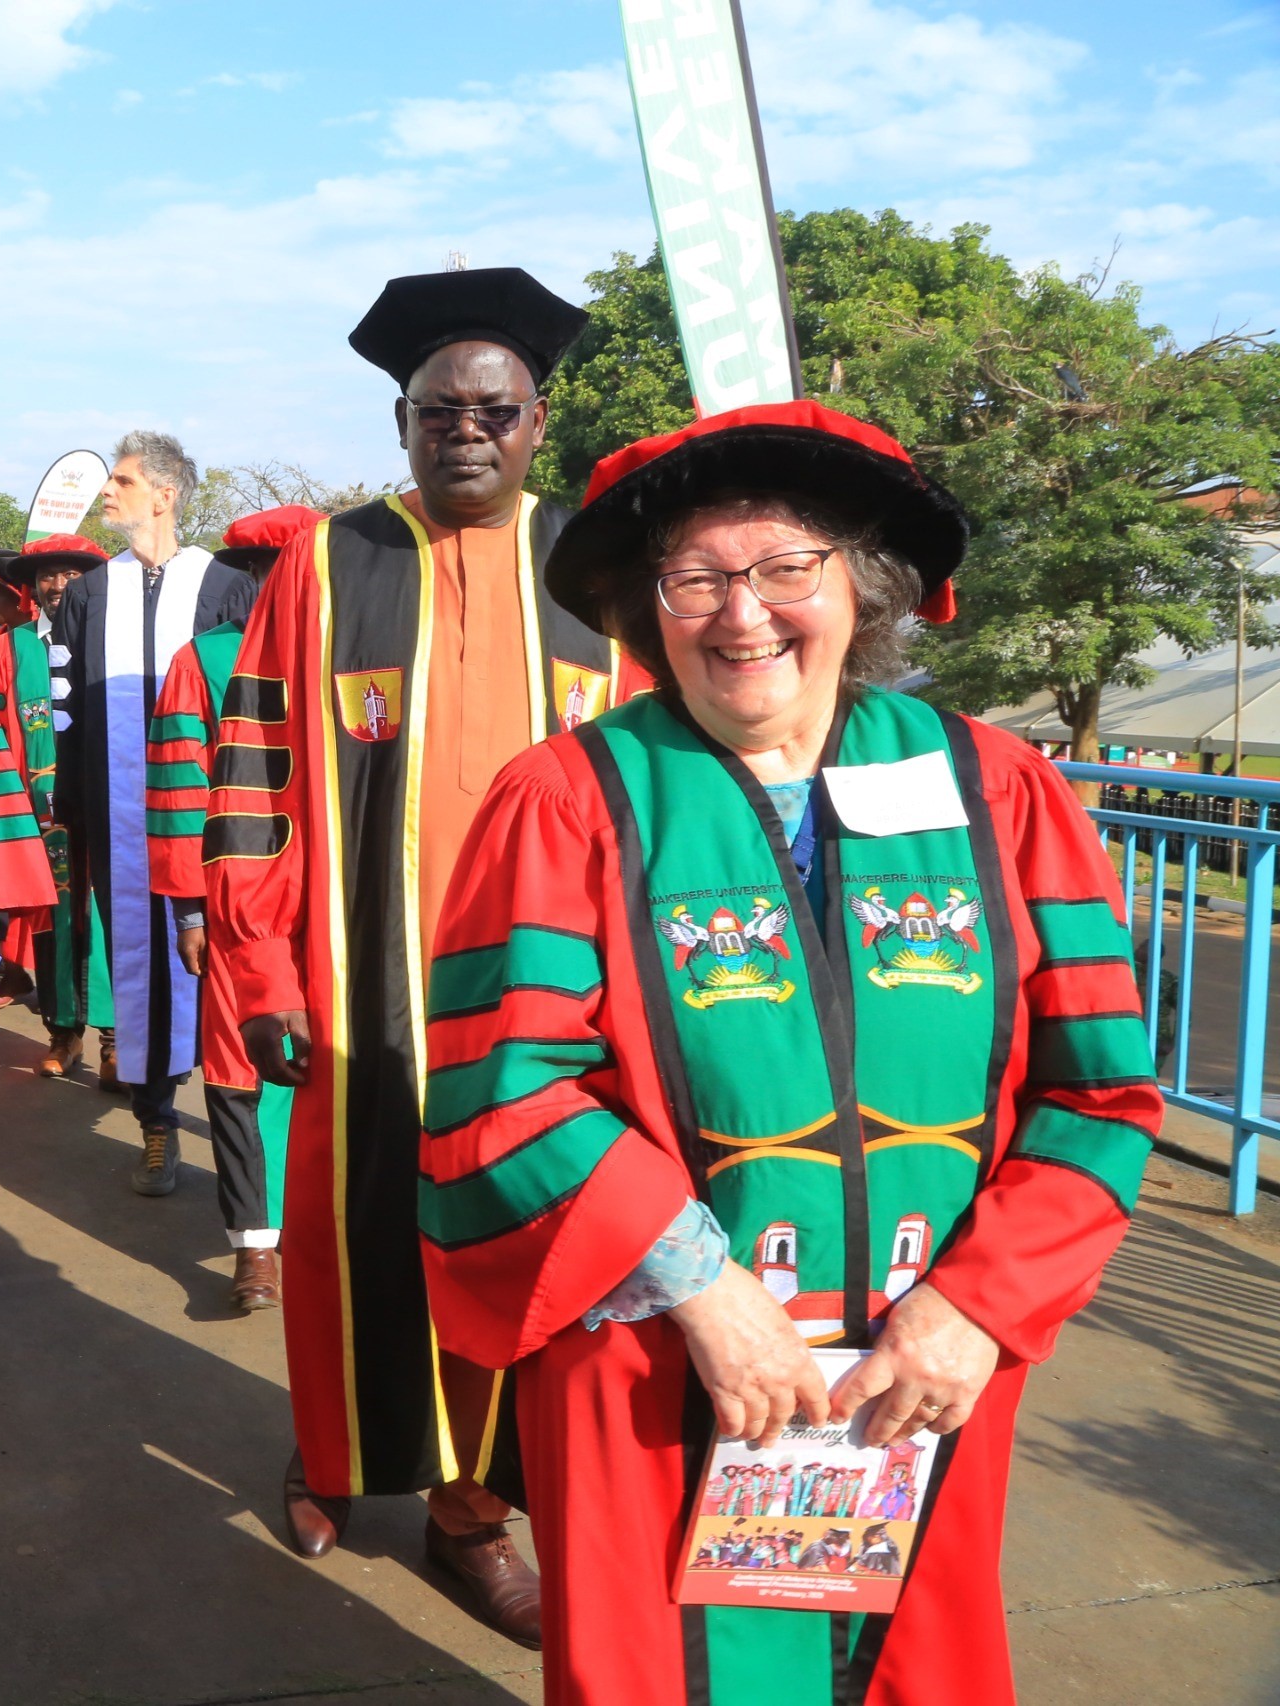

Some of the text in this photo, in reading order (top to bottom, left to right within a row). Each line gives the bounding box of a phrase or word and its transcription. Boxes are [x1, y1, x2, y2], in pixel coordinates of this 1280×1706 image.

[38, 498, 49, 506] WE
[72, 502, 84, 511] FOR
[841, 873, 980, 887] MAKERERE UNIVERSITY
[648, 884, 786, 906] MAKERERE UNIVERSITY
